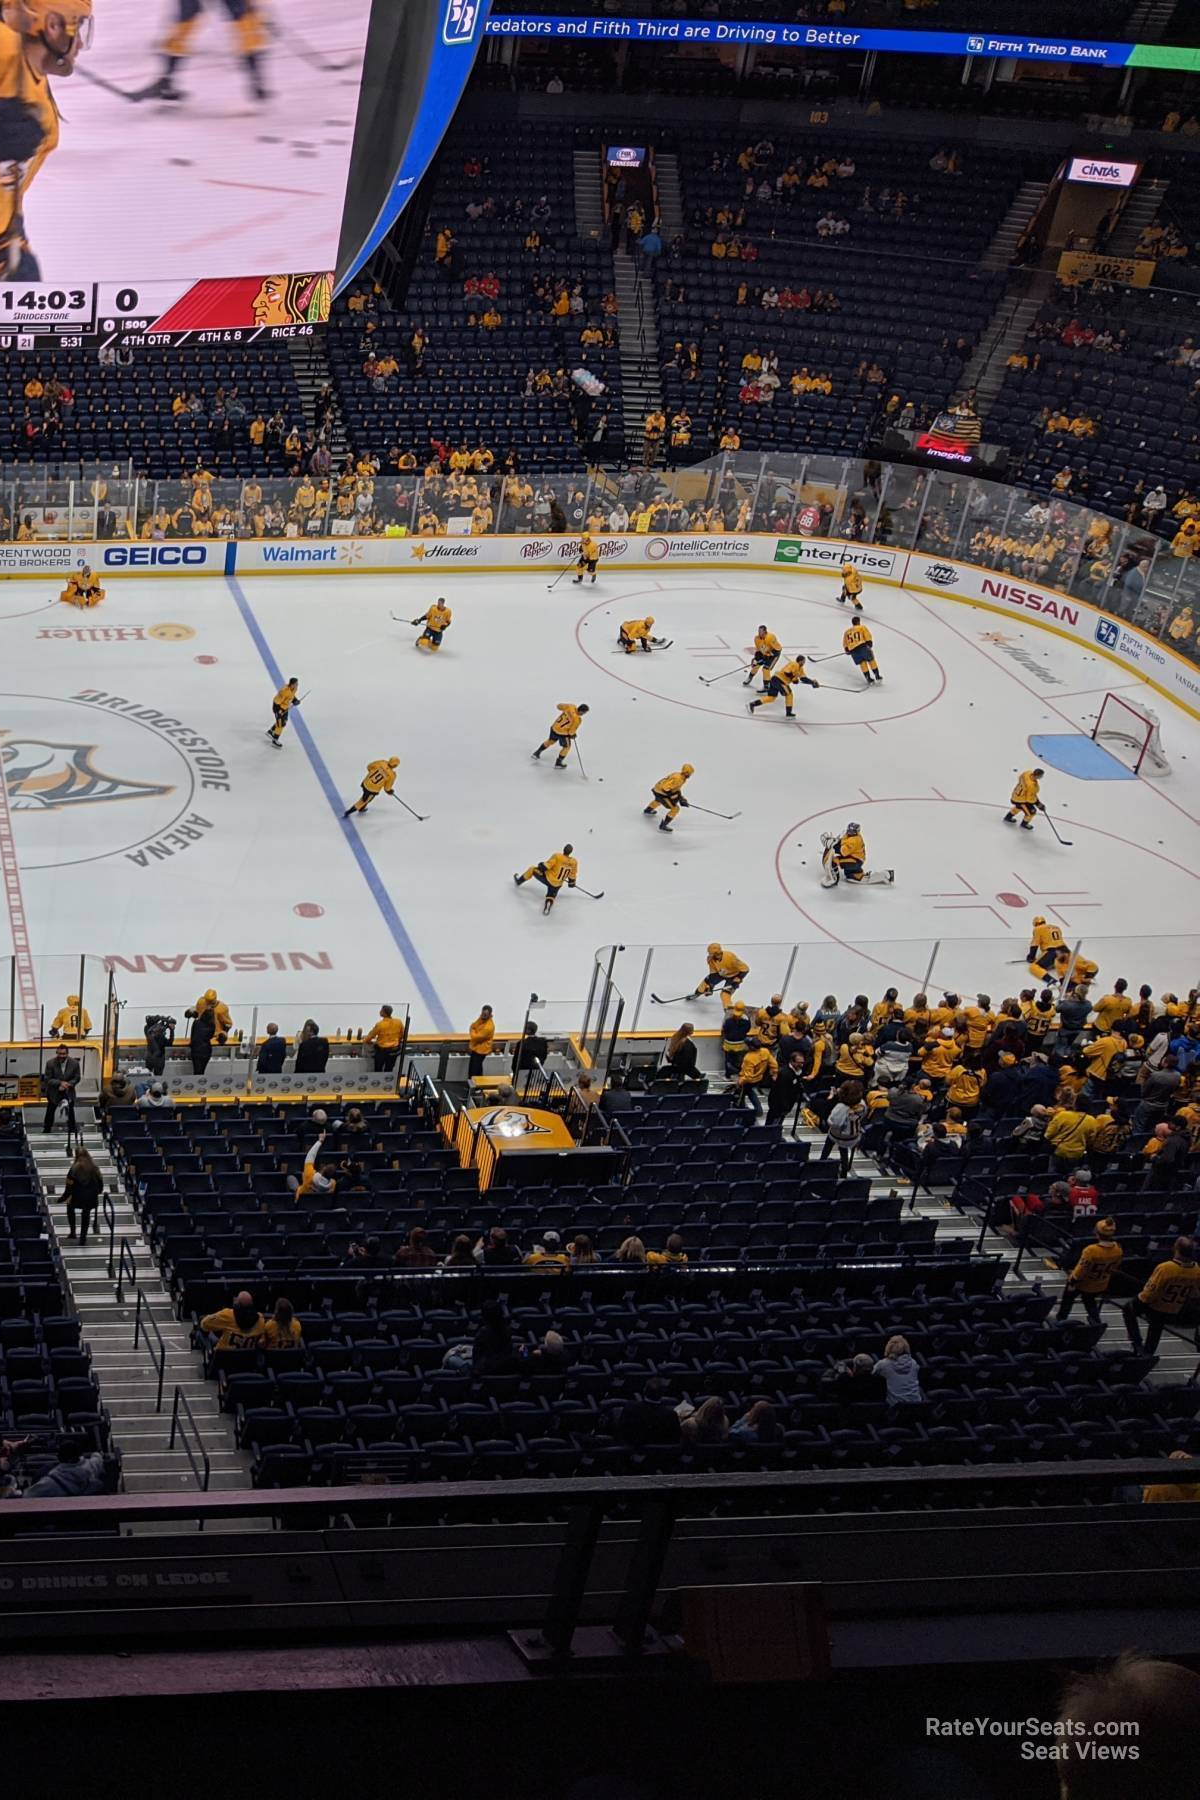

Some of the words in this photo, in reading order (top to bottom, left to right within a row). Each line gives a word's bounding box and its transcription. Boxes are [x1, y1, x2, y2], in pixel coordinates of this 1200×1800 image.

[485, 19, 552, 34] redators
[557, 20, 588, 35] and
[594, 21, 631, 36] Fifth
[637, 22, 679, 38] Third
[684, 27, 711, 38] are
[716, 25, 776, 44] Driving
[782, 28, 800, 43] to
[806, 29, 861, 46] Better
[988, 40, 1023, 52] FIFTH
[1027, 43, 1067, 56] THIRD
[1070, 46, 1108, 59] BANK
[810, 111, 829, 124] 103
[2, 290, 87, 312] 14:03
[116, 288, 139, 312] 0
[13, 312, 70, 321] BRIDGESTONE
[103, 319, 116, 332] 0
[125, 320, 148, 330] SOG
[272, 327, 296, 338] RICE
[299, 326, 314, 336] 46
[21, 336, 32, 348] 21
[60, 336, 83, 348] 5:31
[122, 335, 147, 346] 4TH
[150, 334, 171, 346] QTR
[198, 332, 221, 342] 4TH
[224, 332, 232, 341] &
[234, 331, 242, 341] 8
[927, 448, 972, 462] imaging
[800, 514, 814, 528] 88
[523, 545, 550, 558] Pepper
[669, 540, 750, 551] IntelliCentrics
[104, 546, 207, 566] GEICO
[263, 546, 336, 561] Walmart
[783, 546, 892, 569] enterprise
[19, 558, 71, 567] BROKERS
[925, 566, 959, 583] NHL
[981, 579, 1080, 626] NISSAN
[36, 627, 148, 642] Hiller
[1120, 643, 1141, 660] BANK
[1122, 633, 1143, 651] FIFTH
[1144, 645, 1166, 665] THIRD
[69, 689, 231, 792] BRIDGESTONE
[369, 770, 384, 784] 19
[124, 812, 214, 868] ARENA
[104, 952, 334, 973] NISSAN
[22, 1575, 108, 1590] DRINKS
[116, 1574, 148, 1587] ON
[156, 1572, 230, 1586] LEDGE
